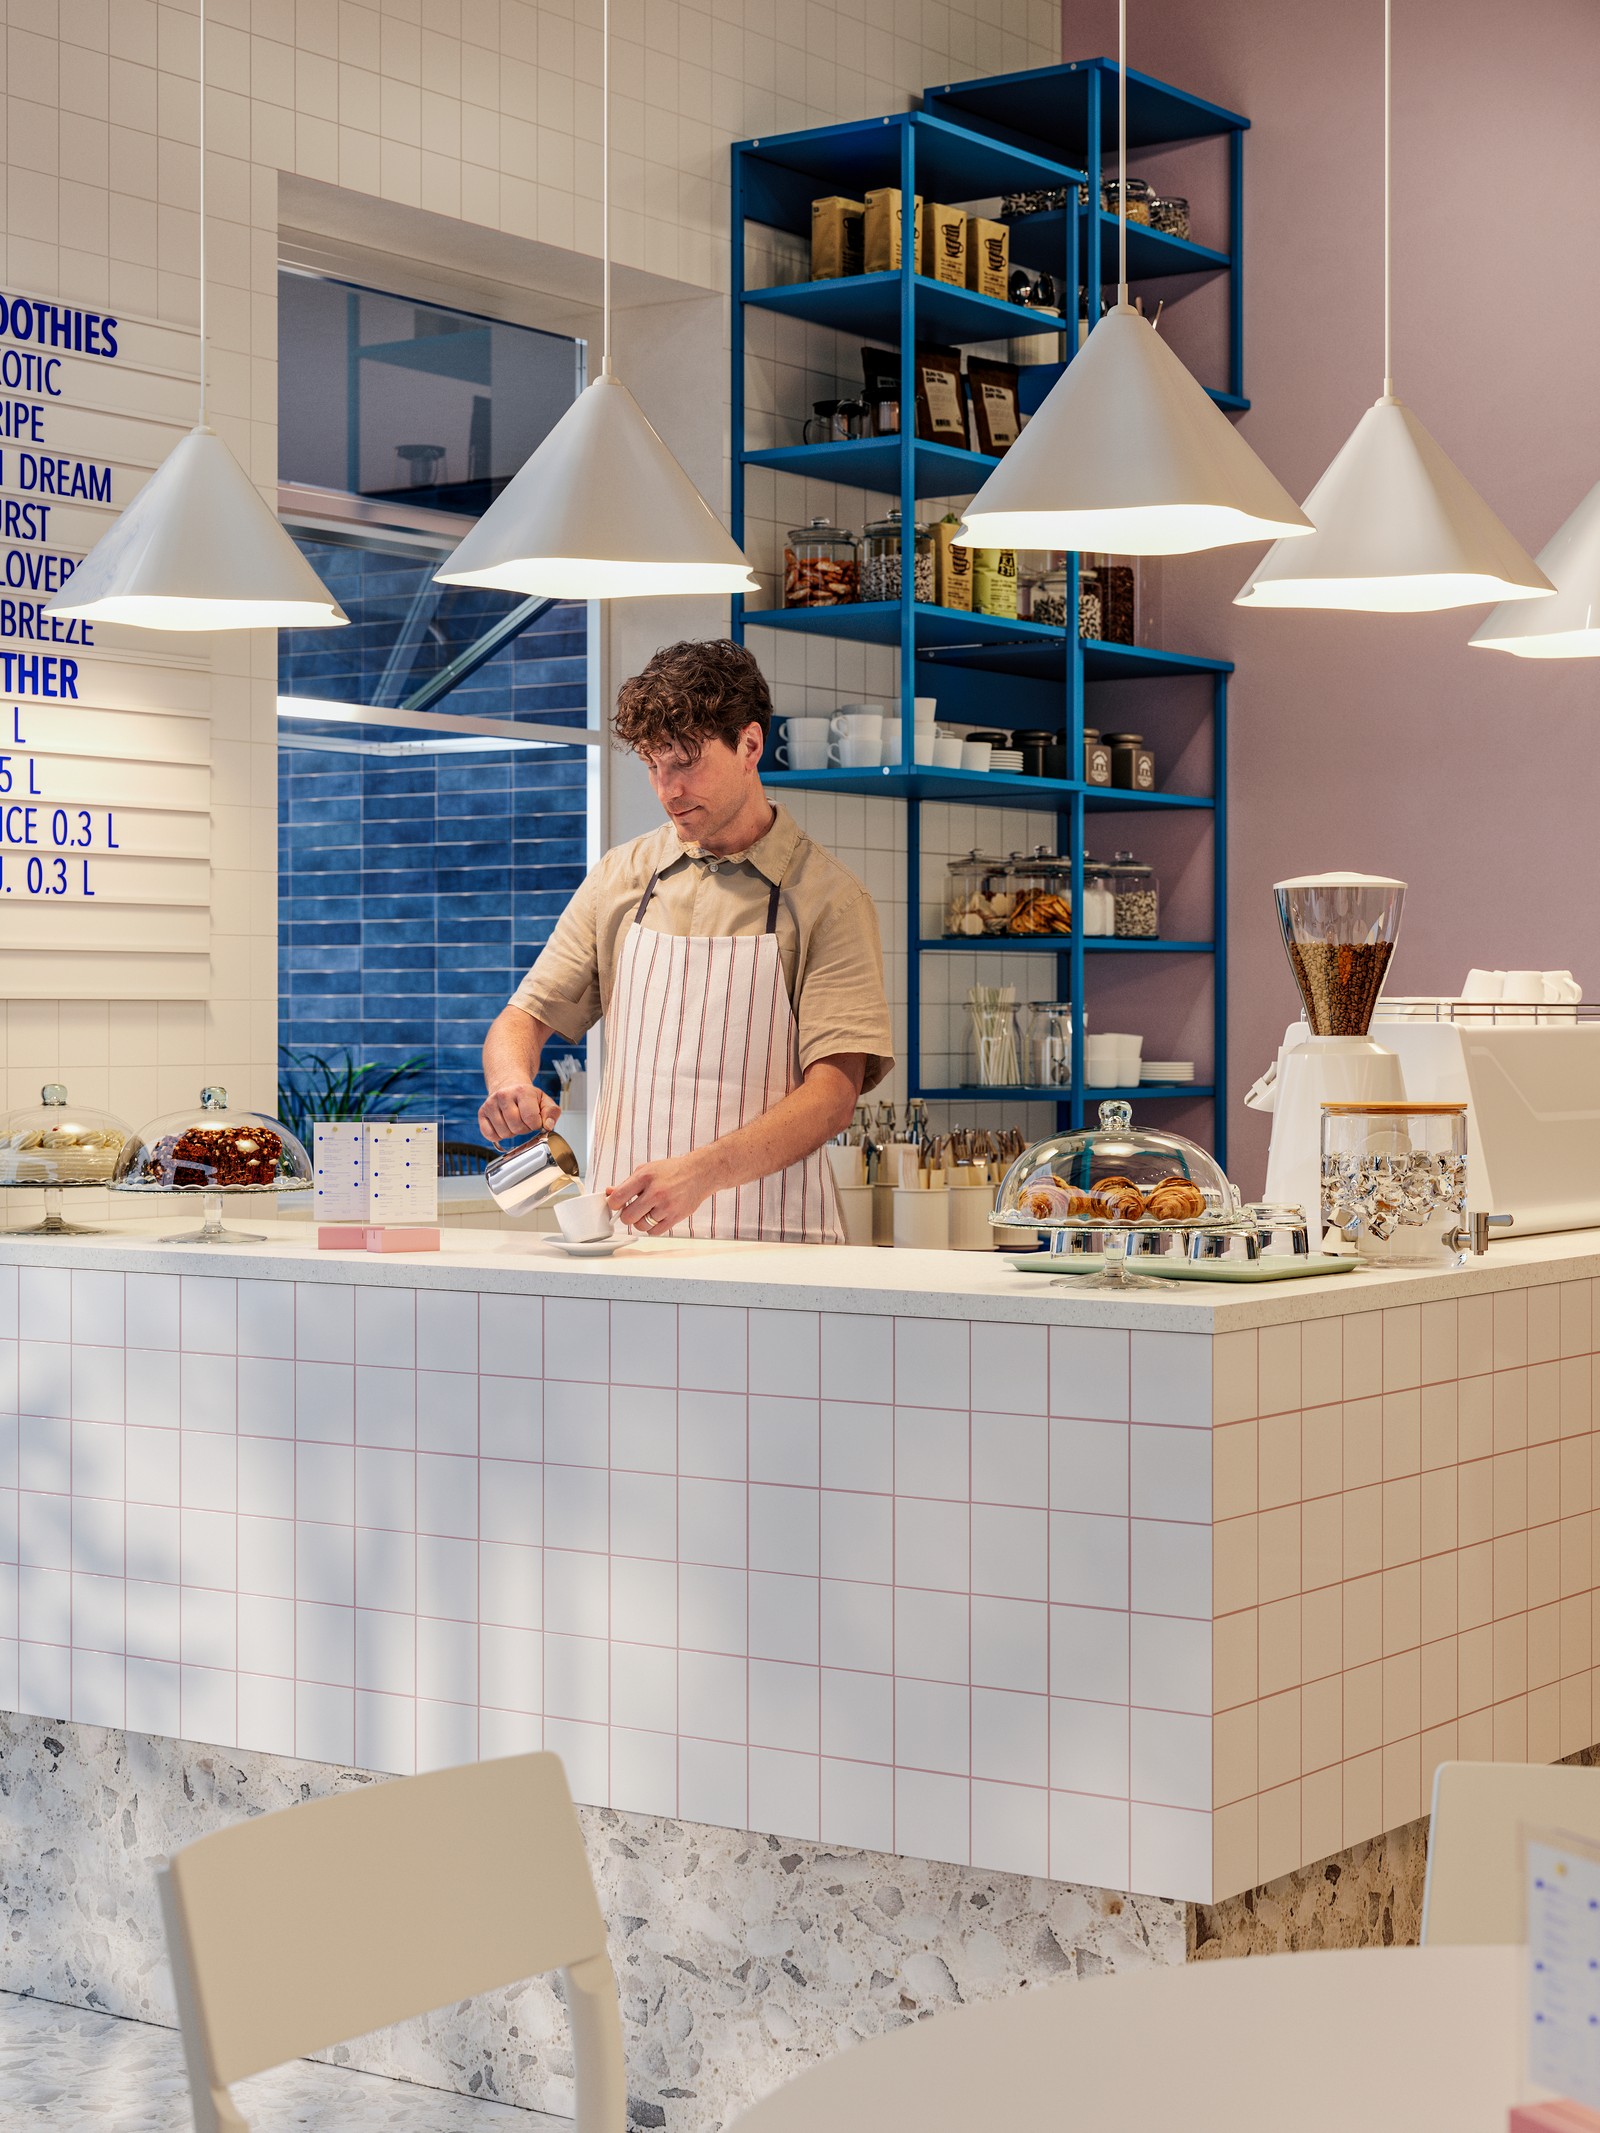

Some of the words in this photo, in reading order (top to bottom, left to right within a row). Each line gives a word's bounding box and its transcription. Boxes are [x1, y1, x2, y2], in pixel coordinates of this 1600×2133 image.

[0, 349, 62, 396] OTIC
[0, 400, 45, 443] IPE
[20, 453, 111, 503] DREAM
[0, 499, 51, 542] RST
[1, 599, 94, 646] BREEZE
[0, 652, 78, 699] THER
[14, 706, 26, 743] L
[30, 758, 41, 794] L
[108, 813, 119, 848] L
[83, 860, 95, 895] L
